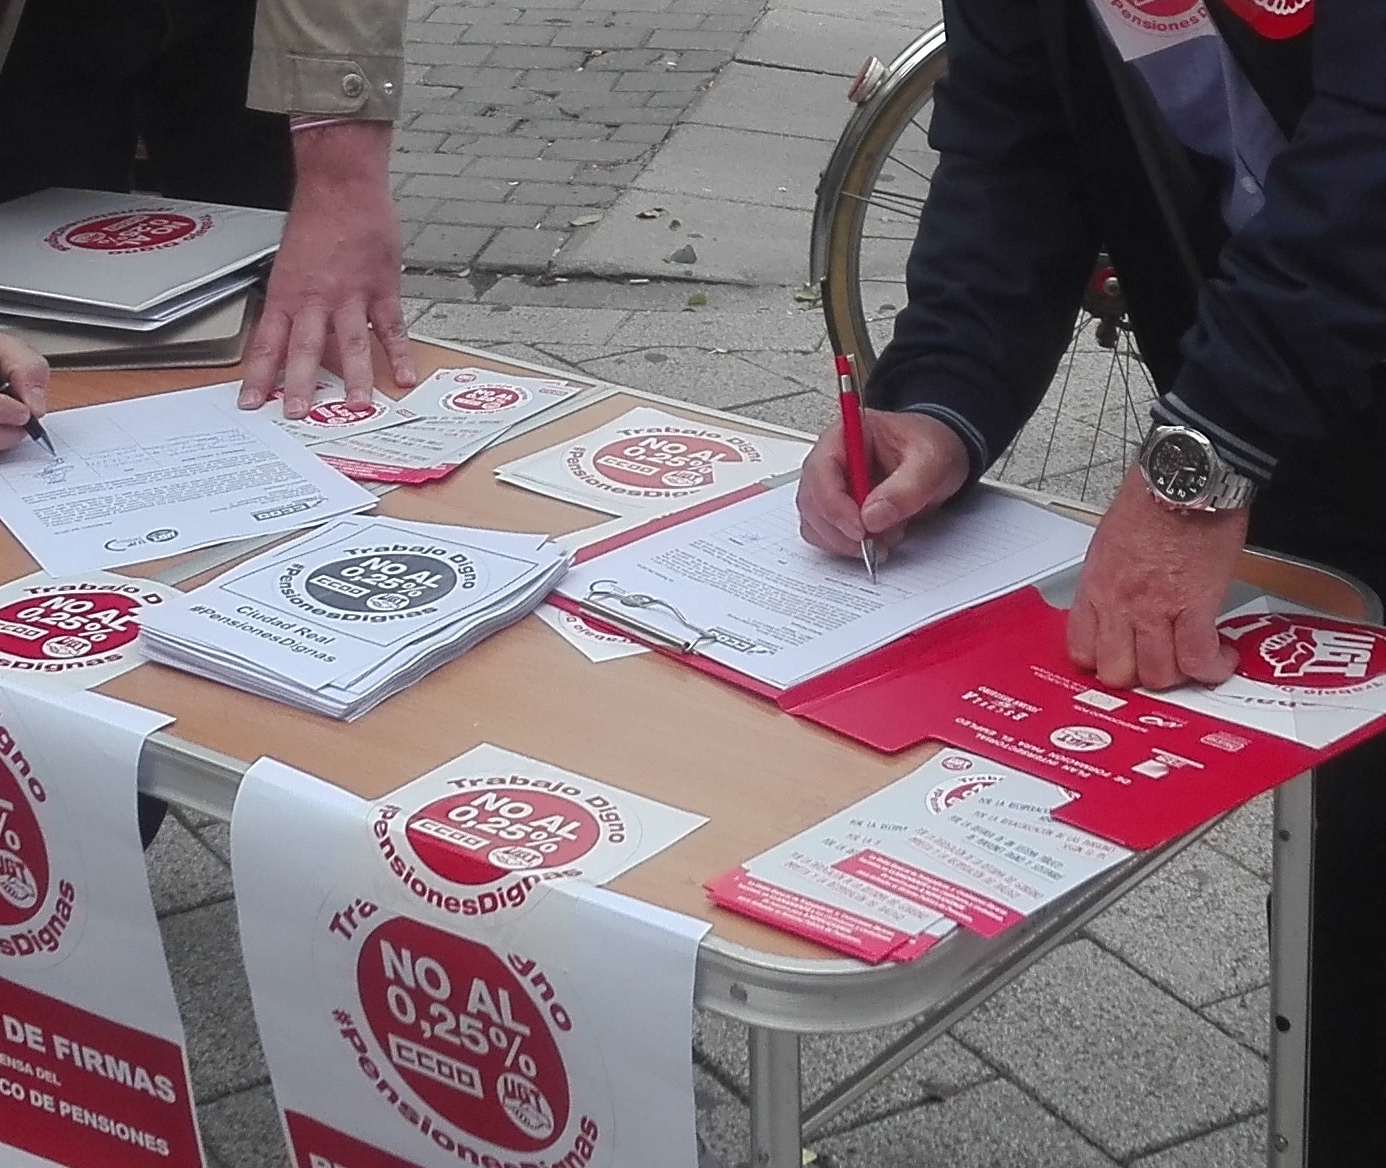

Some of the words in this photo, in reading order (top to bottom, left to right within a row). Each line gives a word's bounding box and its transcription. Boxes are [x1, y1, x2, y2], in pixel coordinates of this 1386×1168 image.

[616, 426, 722, 439] Trabajo
[638, 437, 688, 454] NO
[603, 458, 656, 474] CCOO
[623, 446, 713, 474] 0,25%
[339, 566, 423, 599] 0,25%
[342, 543, 447, 557] Trabajo
[448, 554, 476, 589] Digno
[359, 557, 402, 575] NO
[402, 570, 443, 590] AL
[23, 583, 140, 596] Trabajo
[276, 563, 439, 623] #PensionesDignas
[317, 577, 363, 596] CCOO
[40, 597, 95, 613] NO
[16, 607, 107, 643] 0,25%
[188, 604, 337, 664] #PensionesDignas
[236, 605, 293, 631] Ciudad
[294, 626, 336, 645] Real
[1312, 628, 1376, 677] UGT
[955, 717, 997, 736] EMPLEO
[1017, 740, 1045, 753] PARA
[1061, 764, 1092, 778] PLAN
[447, 775, 582, 798] Trabajo
[584, 793, 625, 845] Digno
[470, 791, 535, 821] NO
[531, 813, 582, 843] AL
[418, 819, 482, 848] CCOO
[446, 805, 560, 856] 0,25%
[373, 801, 583, 917] #PensionesDignas
[378, 939, 451, 1001] NO
[468, 977, 531, 1036] AL
[386, 984, 537, 1077] 0,25%
[2, 1013, 48, 1054] DE
[53, 1033, 177, 1105] FIRMAS
[36, 1064, 63, 1087] DEL
[394, 1040, 476, 1090] CCOO
[29, 1088, 56, 1115] DE
[60, 1099, 171, 1158] PENSIONES
